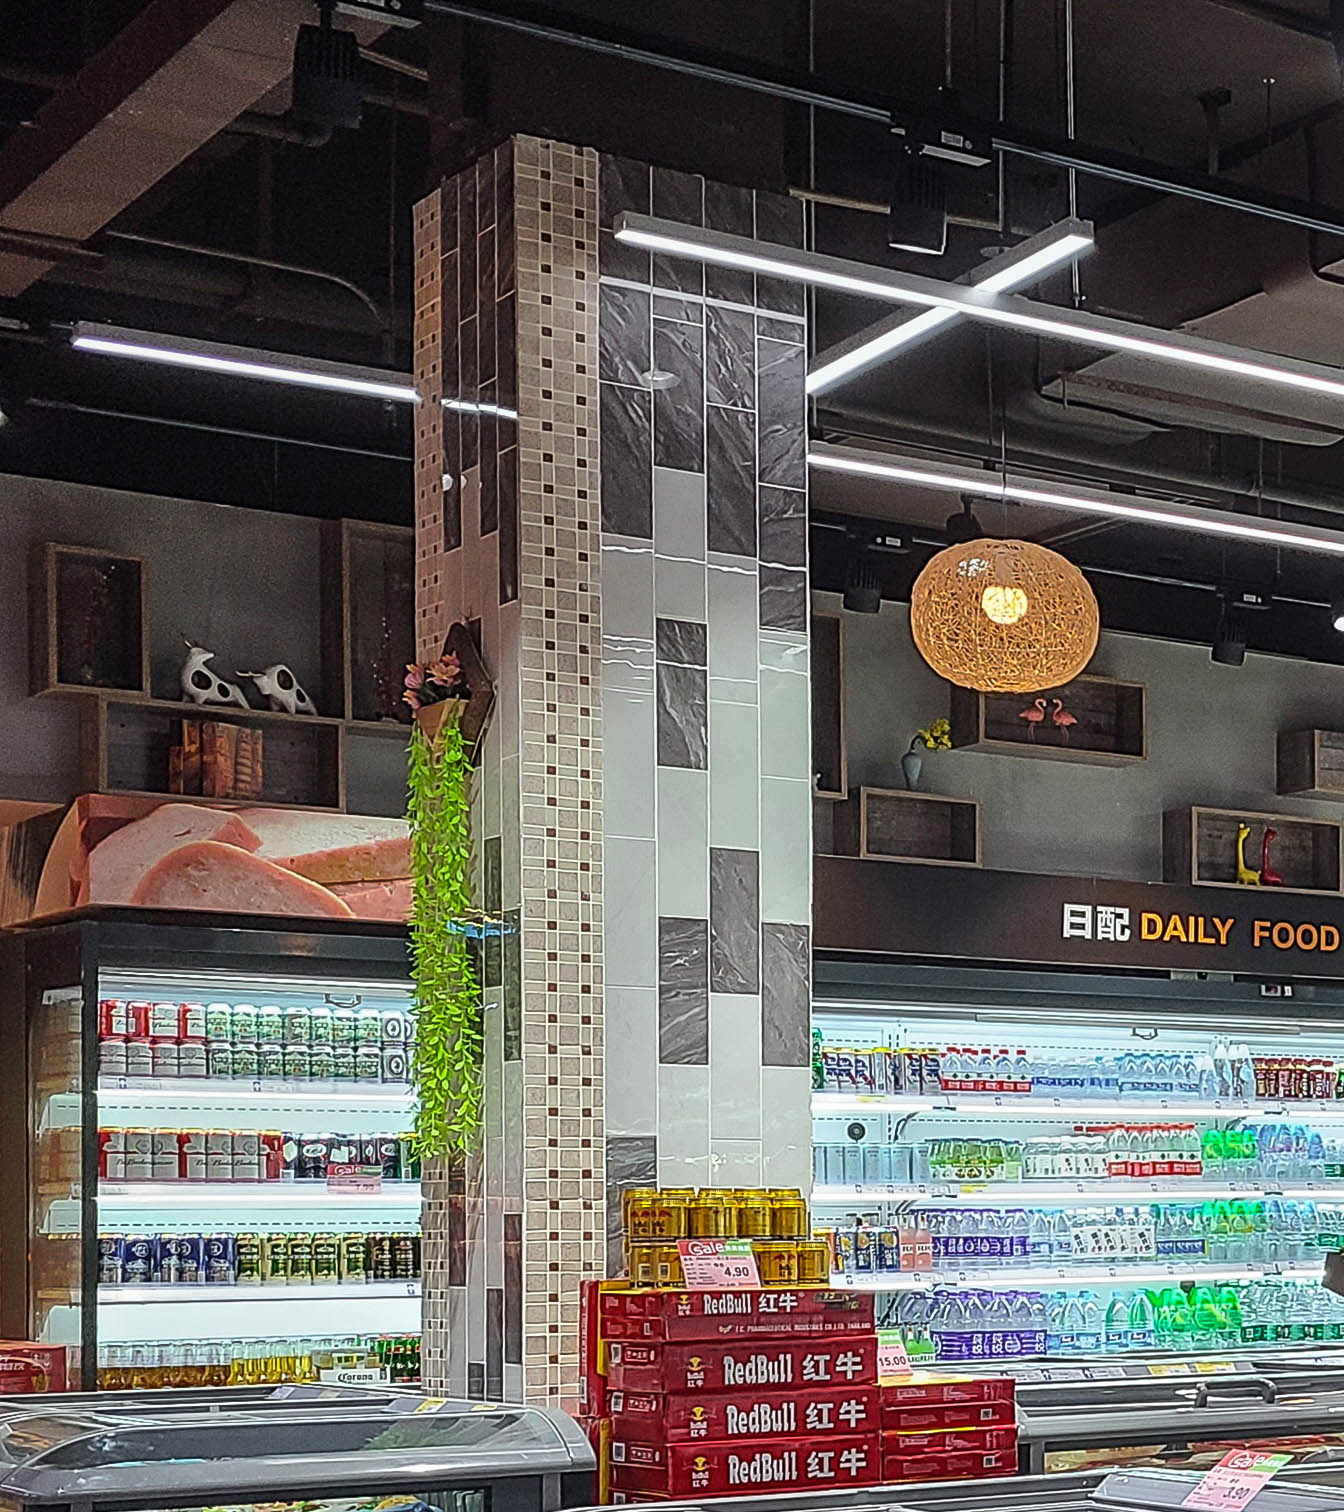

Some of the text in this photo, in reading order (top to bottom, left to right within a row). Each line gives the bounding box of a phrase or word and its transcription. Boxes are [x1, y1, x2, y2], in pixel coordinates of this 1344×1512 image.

[1062, 903, 1341, 951] 日配 DAILY FOOD
[724, 1266, 750, 1277] 4.90
[703, 1292, 798, 1314] RedBull 红牛
[723, 1352, 863, 1386] RedBull 红牛
[879, 1356, 907, 1367] 15.00
[726, 1400, 867, 1435] RedBull 红牛
[728, 1448, 867, 1485] RedBull 红牛
